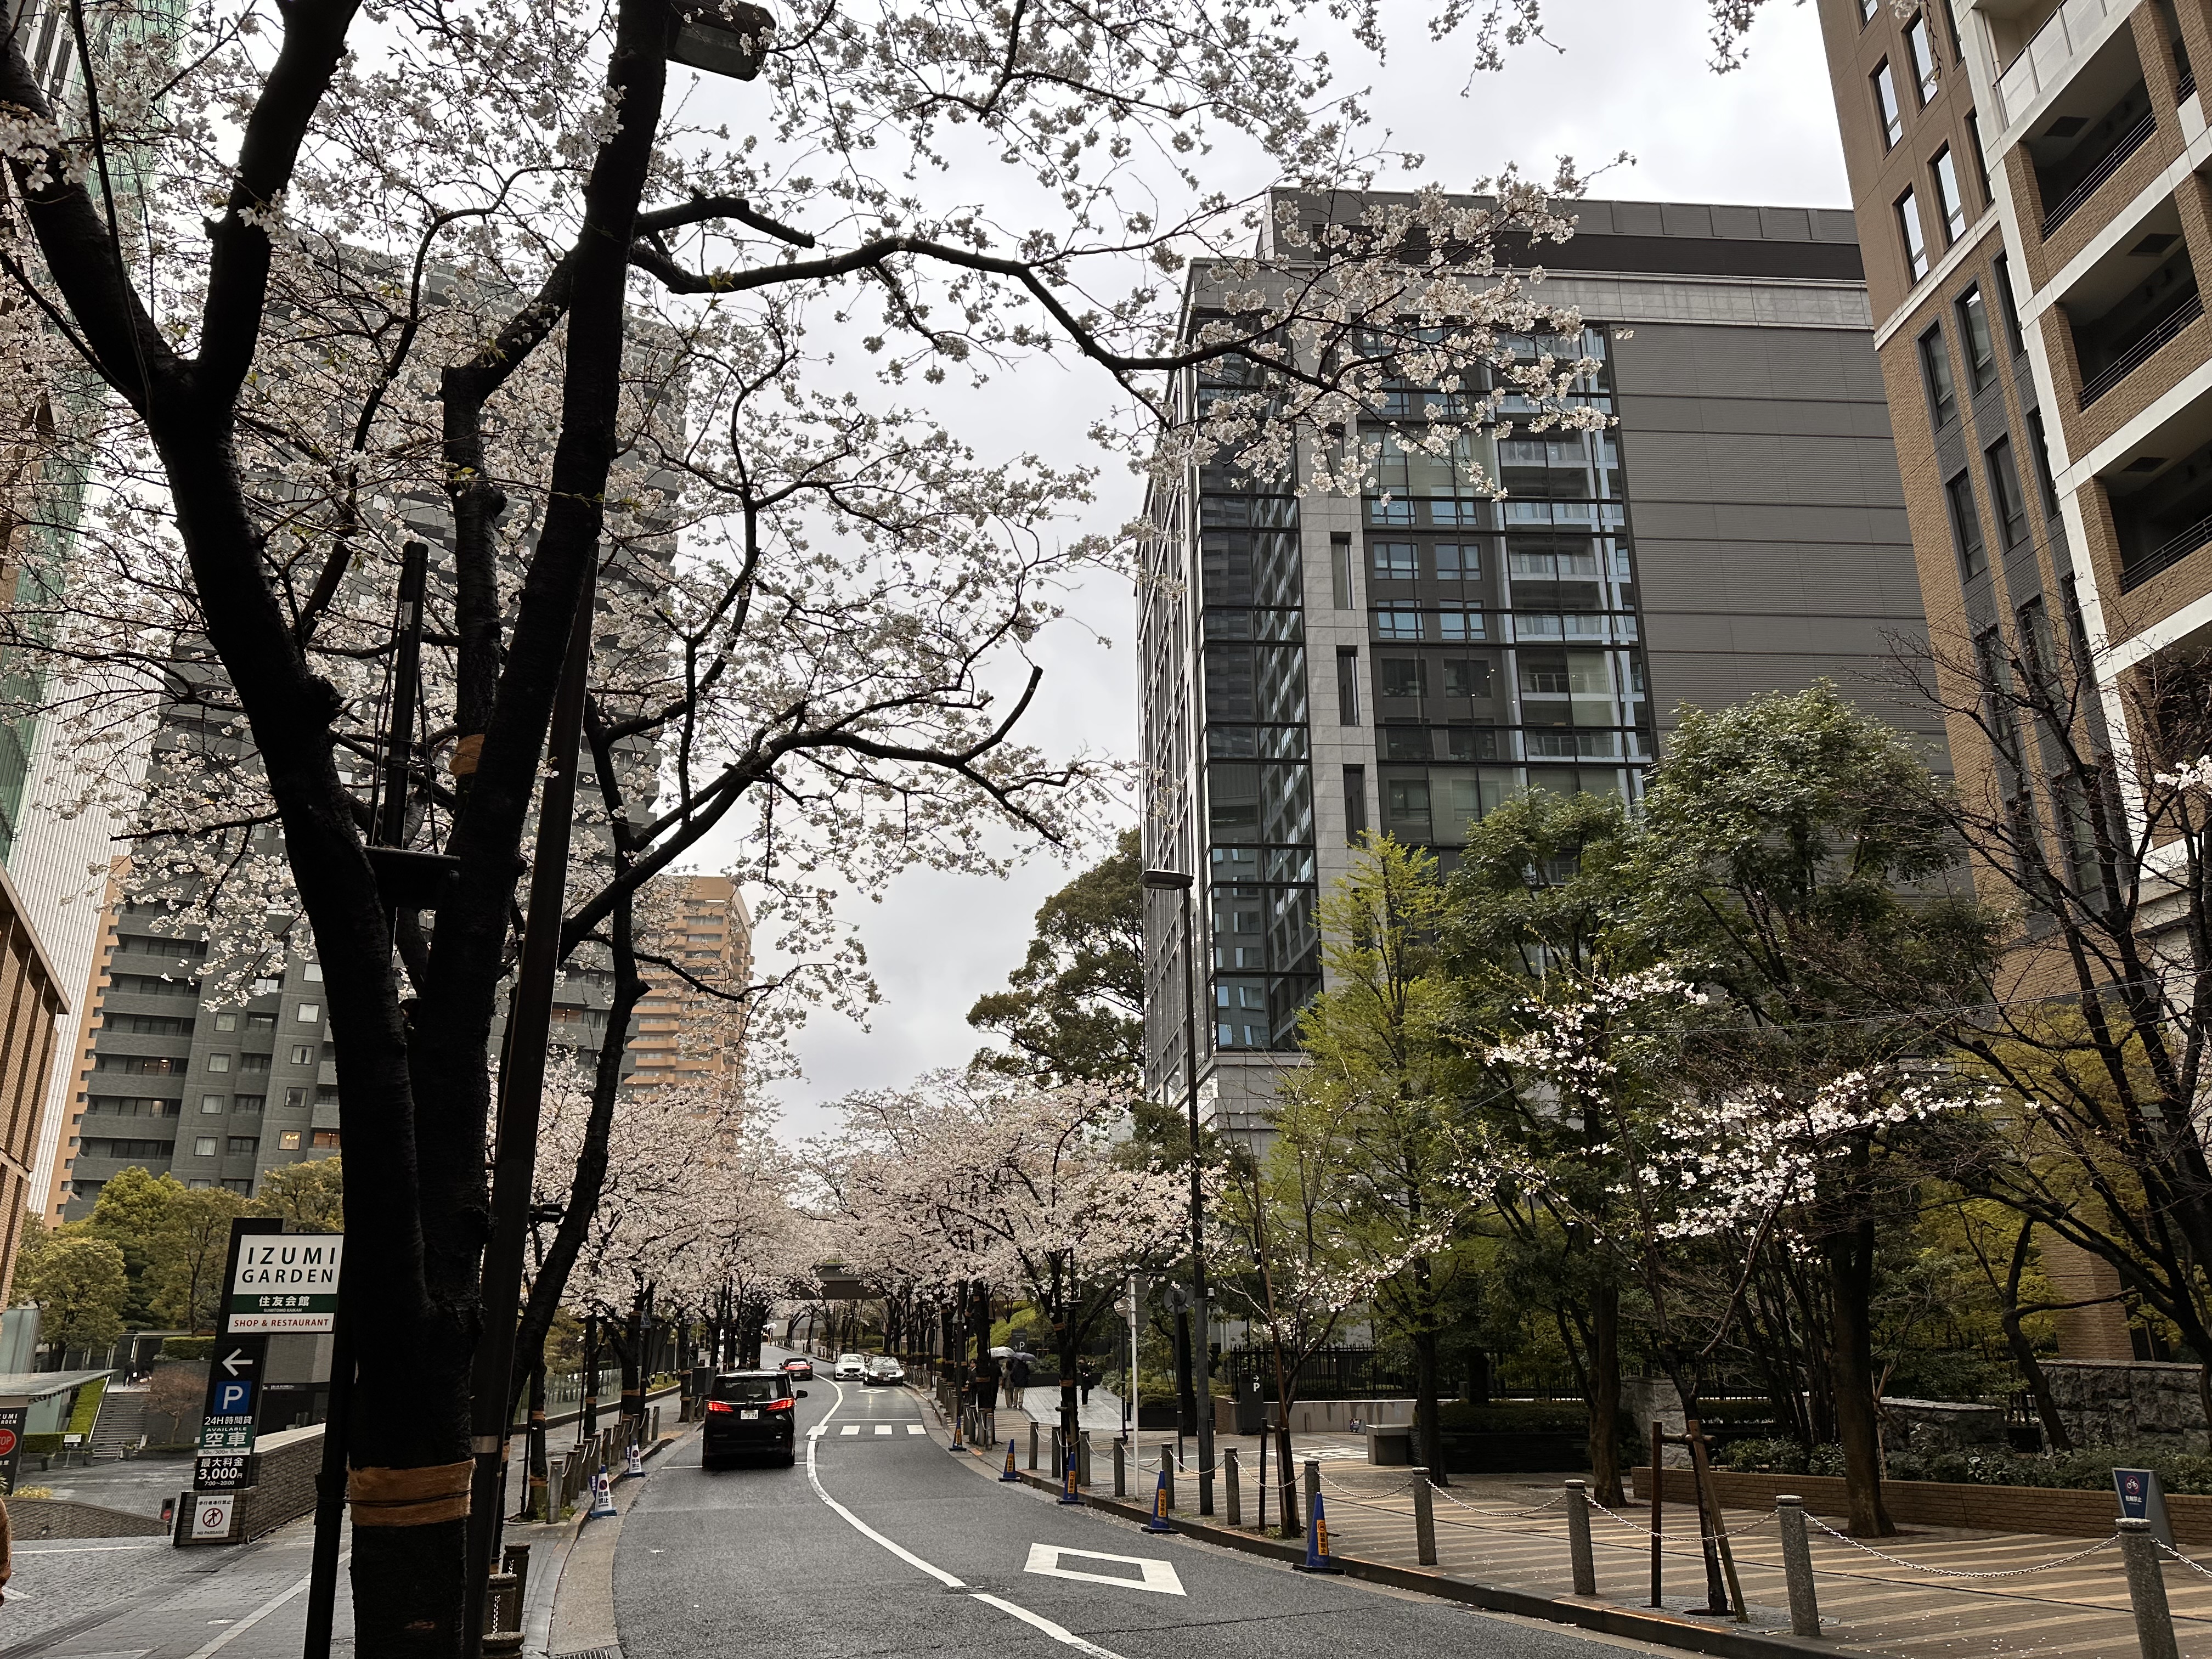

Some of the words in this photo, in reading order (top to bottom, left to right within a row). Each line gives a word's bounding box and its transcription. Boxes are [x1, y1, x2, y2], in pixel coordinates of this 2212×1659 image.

[247, 1247, 336, 1265] IZUMI
[242, 1269, 333, 1283] GARDEN
[259, 1296, 310, 1307] 住友会館
[1019, 1341, 1025, 1350] P
[1253, 1383, 1260, 1392] P
[223, 1386, 243, 1410] P
[0, 1436, 12, 1446] OP
[204, 1431, 247, 1447] 空車
[201, 1457, 244, 1468] 最大料金
[198, 1468, 243, 1481] 3,000円
